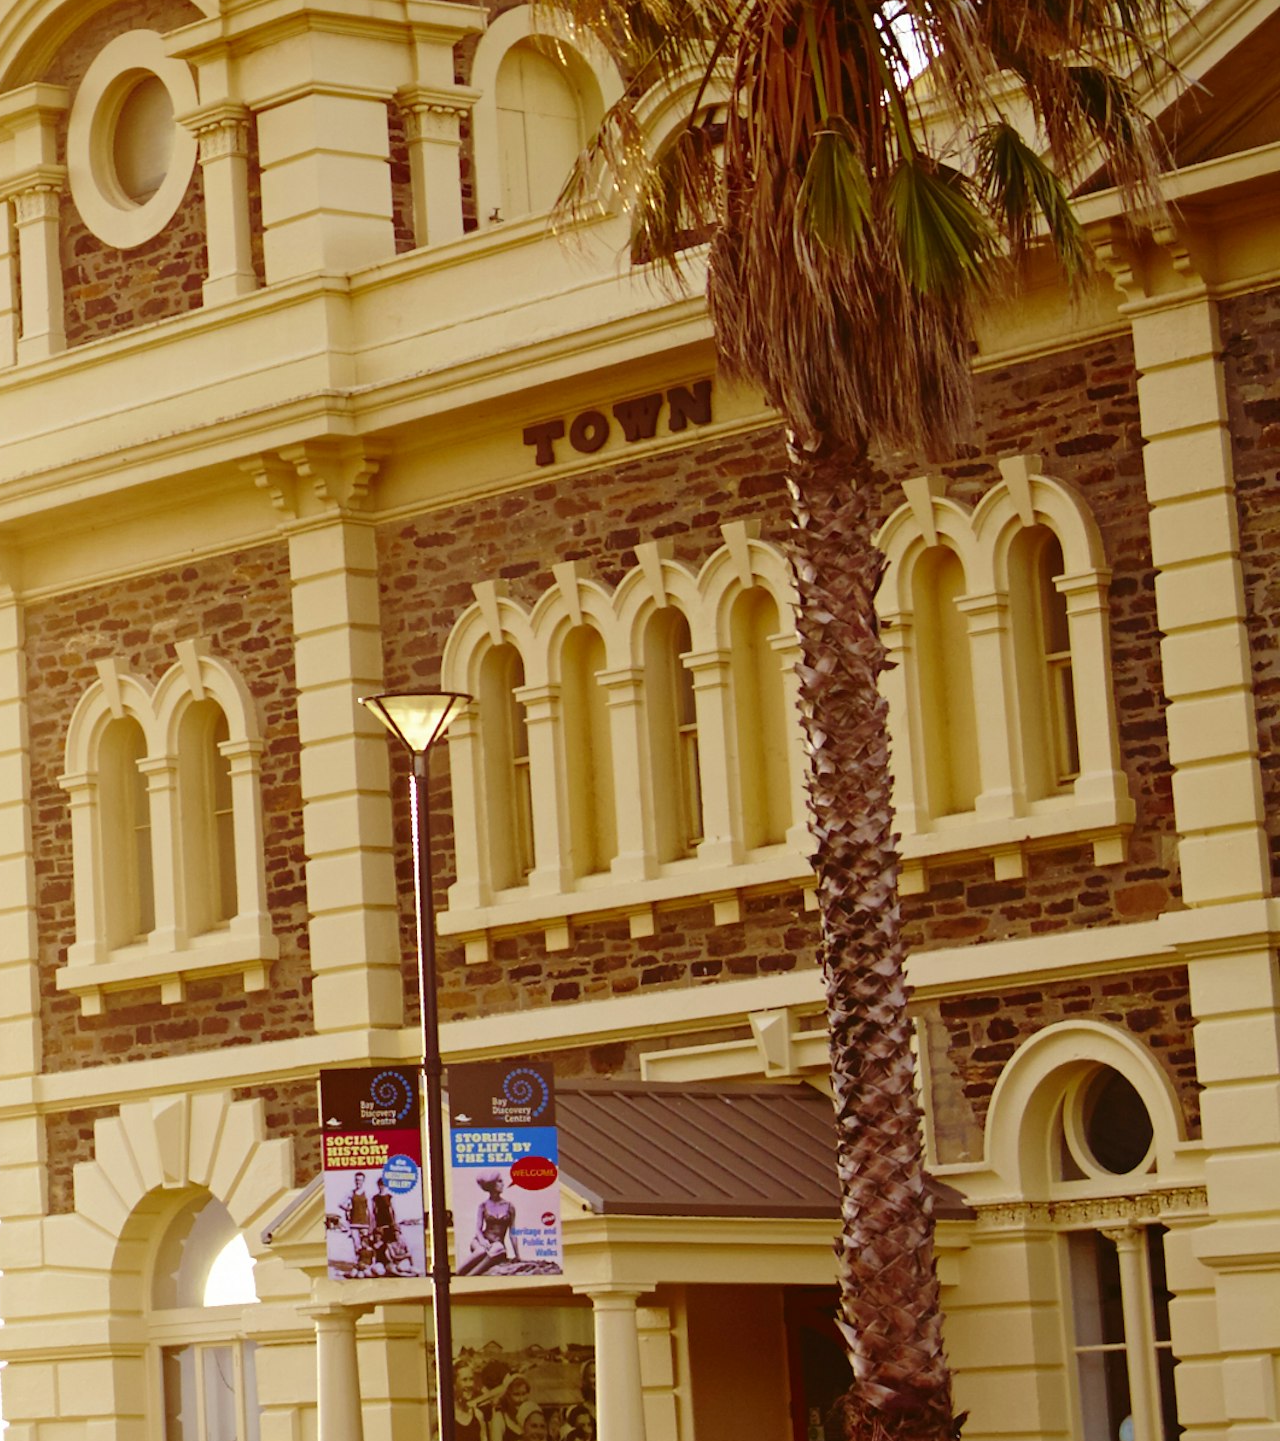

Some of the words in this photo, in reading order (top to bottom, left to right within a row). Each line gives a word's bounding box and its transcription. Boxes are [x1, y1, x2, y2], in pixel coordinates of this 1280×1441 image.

[523, 379, 712, 467] TOWN
[360, 1100, 374, 1110] Bay
[492, 1097, 508, 1107] Bay
[361, 1110, 396, 1118] Discovery
[492, 1106, 531, 1115] Discovery
[371, 1117, 396, 1125] Centre
[504, 1115, 531, 1123] Centre
[326, 1134, 378, 1146] SOCIAL
[455, 1132, 514, 1143] STORIES
[327, 1144, 389, 1157] HISTORY
[456, 1143, 475, 1153] OF
[478, 1142, 510, 1153] LIFE
[512, 1142, 532, 1152] BY
[327, 1155, 388, 1167] MUSEUM
[456, 1153, 484, 1163] THE
[512, 1169, 555, 1177] WELCOME
[523, 1238, 544, 1246] Public
